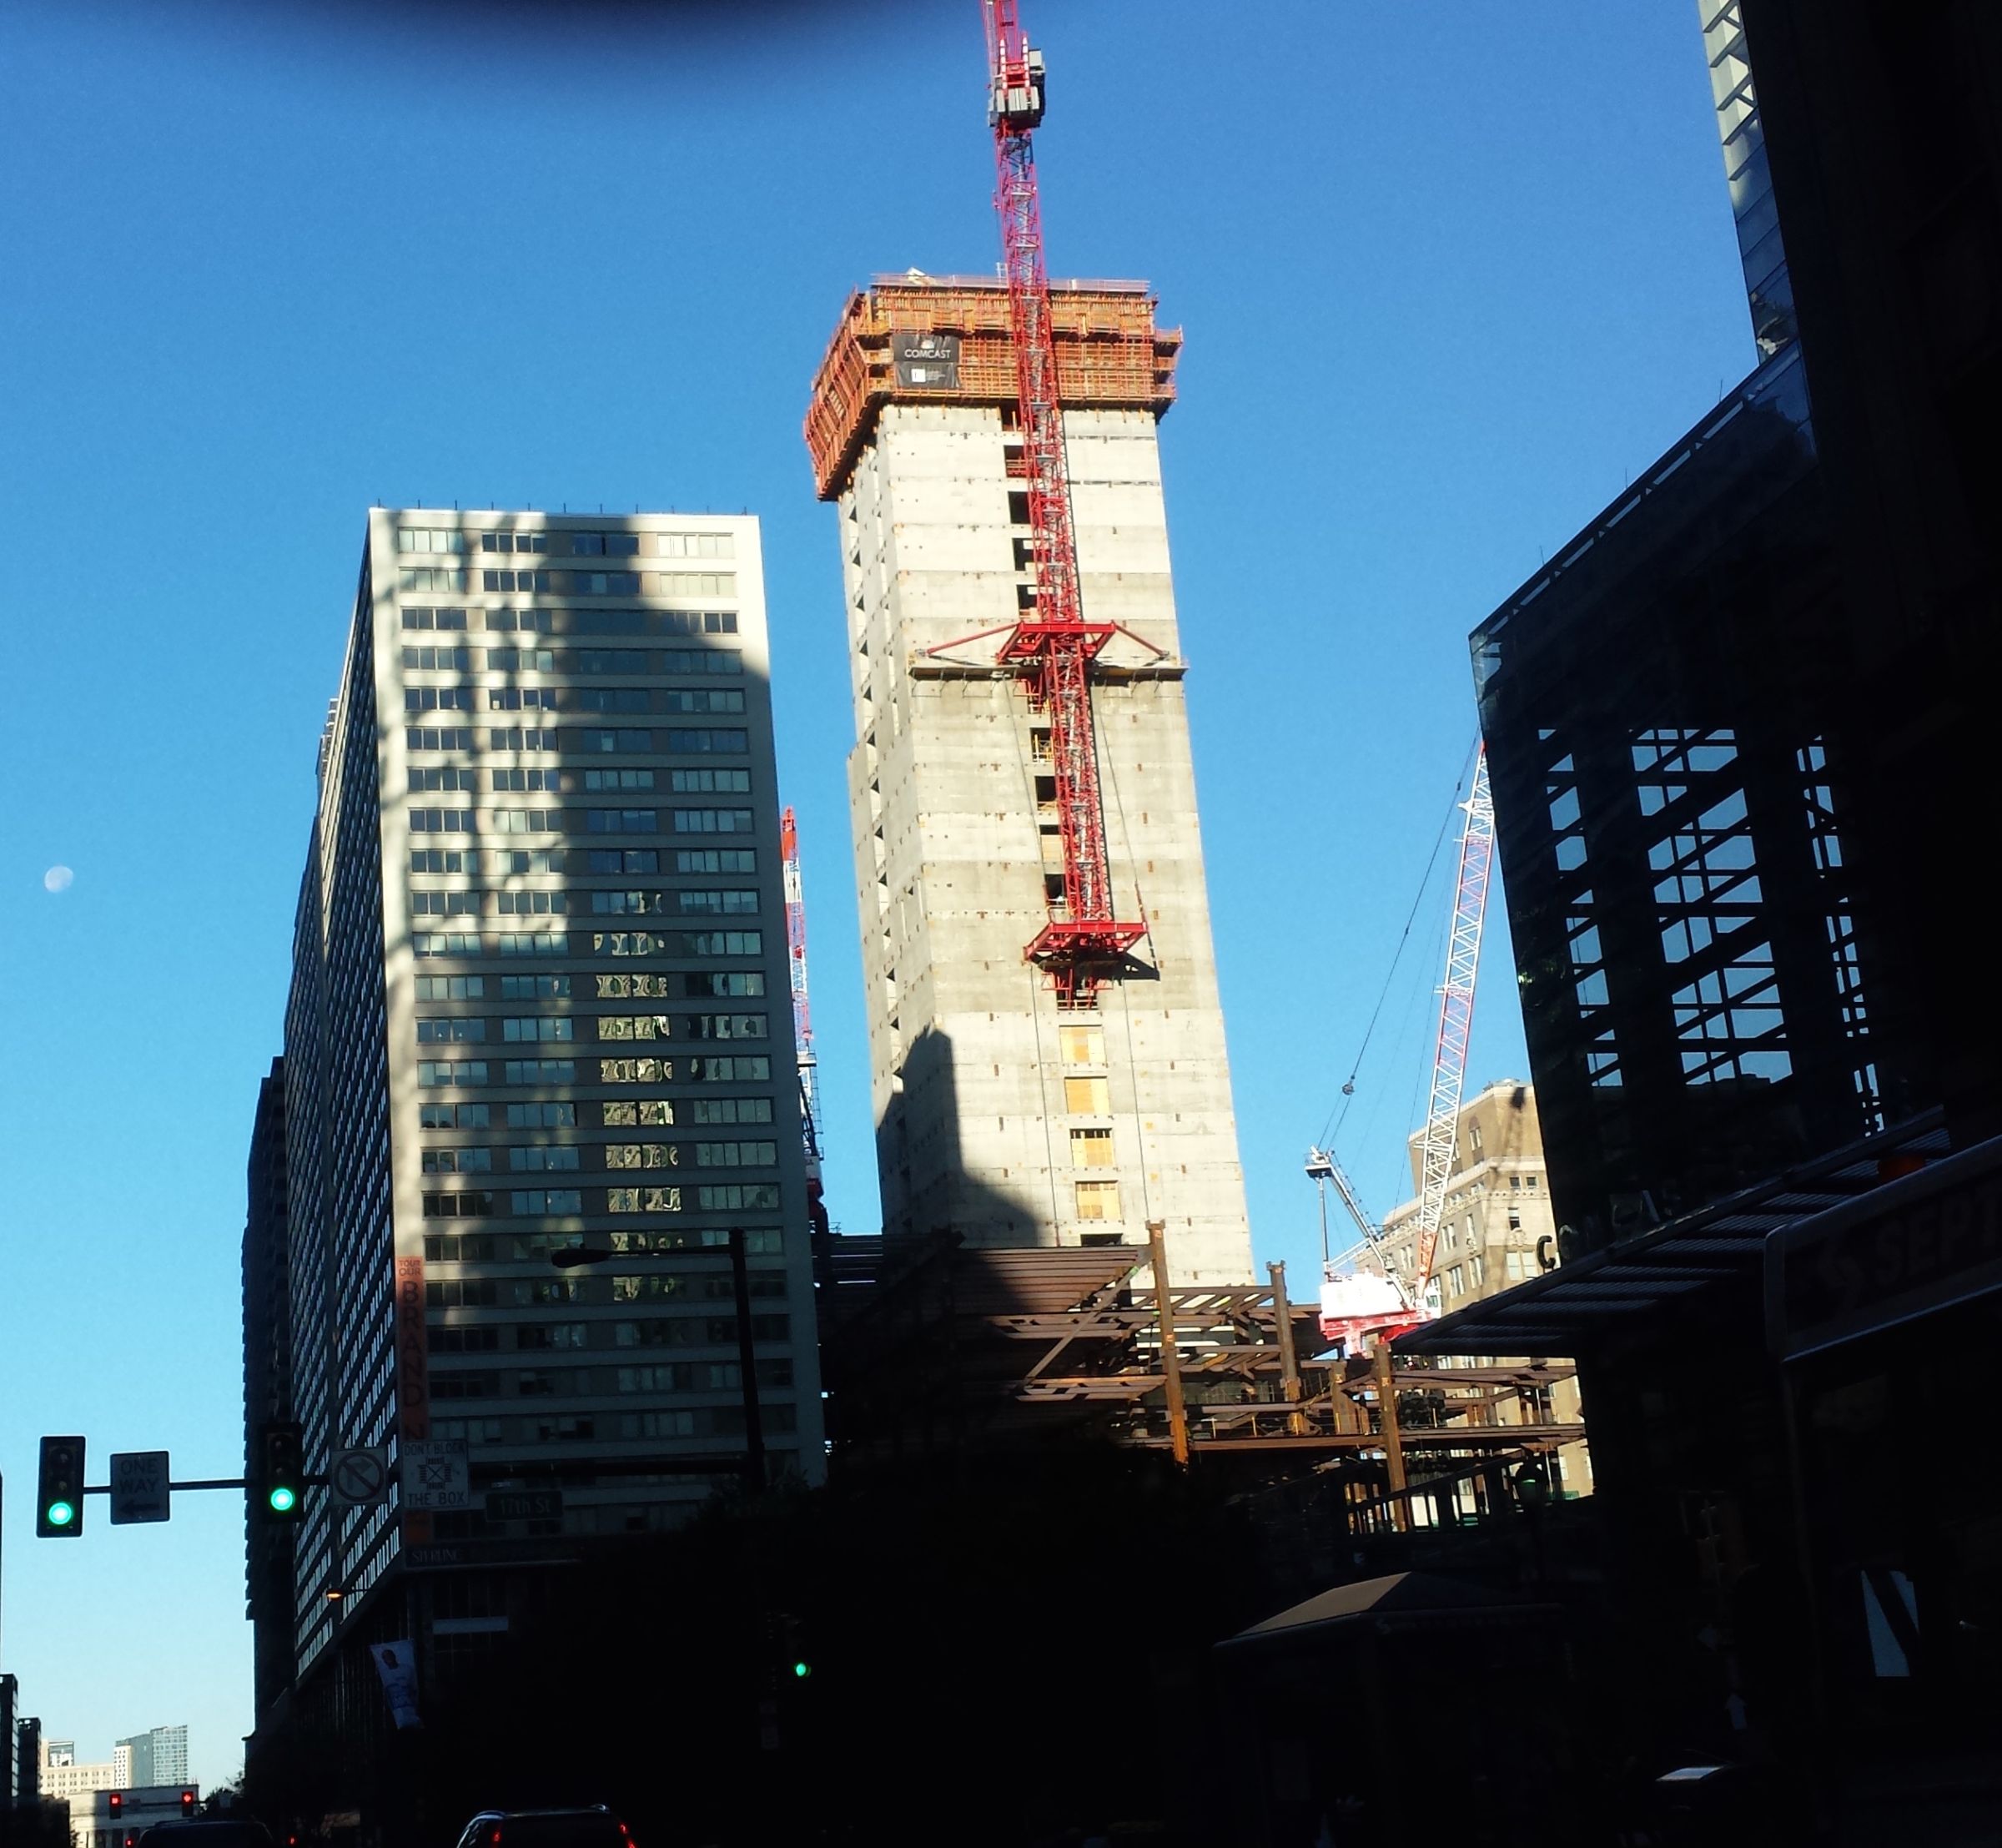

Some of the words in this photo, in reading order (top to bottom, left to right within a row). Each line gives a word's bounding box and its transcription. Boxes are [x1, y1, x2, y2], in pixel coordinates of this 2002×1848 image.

[904, 348, 951, 359] COMCAST
[399, 1267, 421, 1276] OUR
[121, 1457, 158, 1475] ONE
[119, 1478, 158, 1493] WAY
[407, 1493, 431, 1506] THE
[438, 1491, 465, 1505] BOX
[500, 1497, 531, 1516] 17th
[535, 1496, 551, 1514] St
